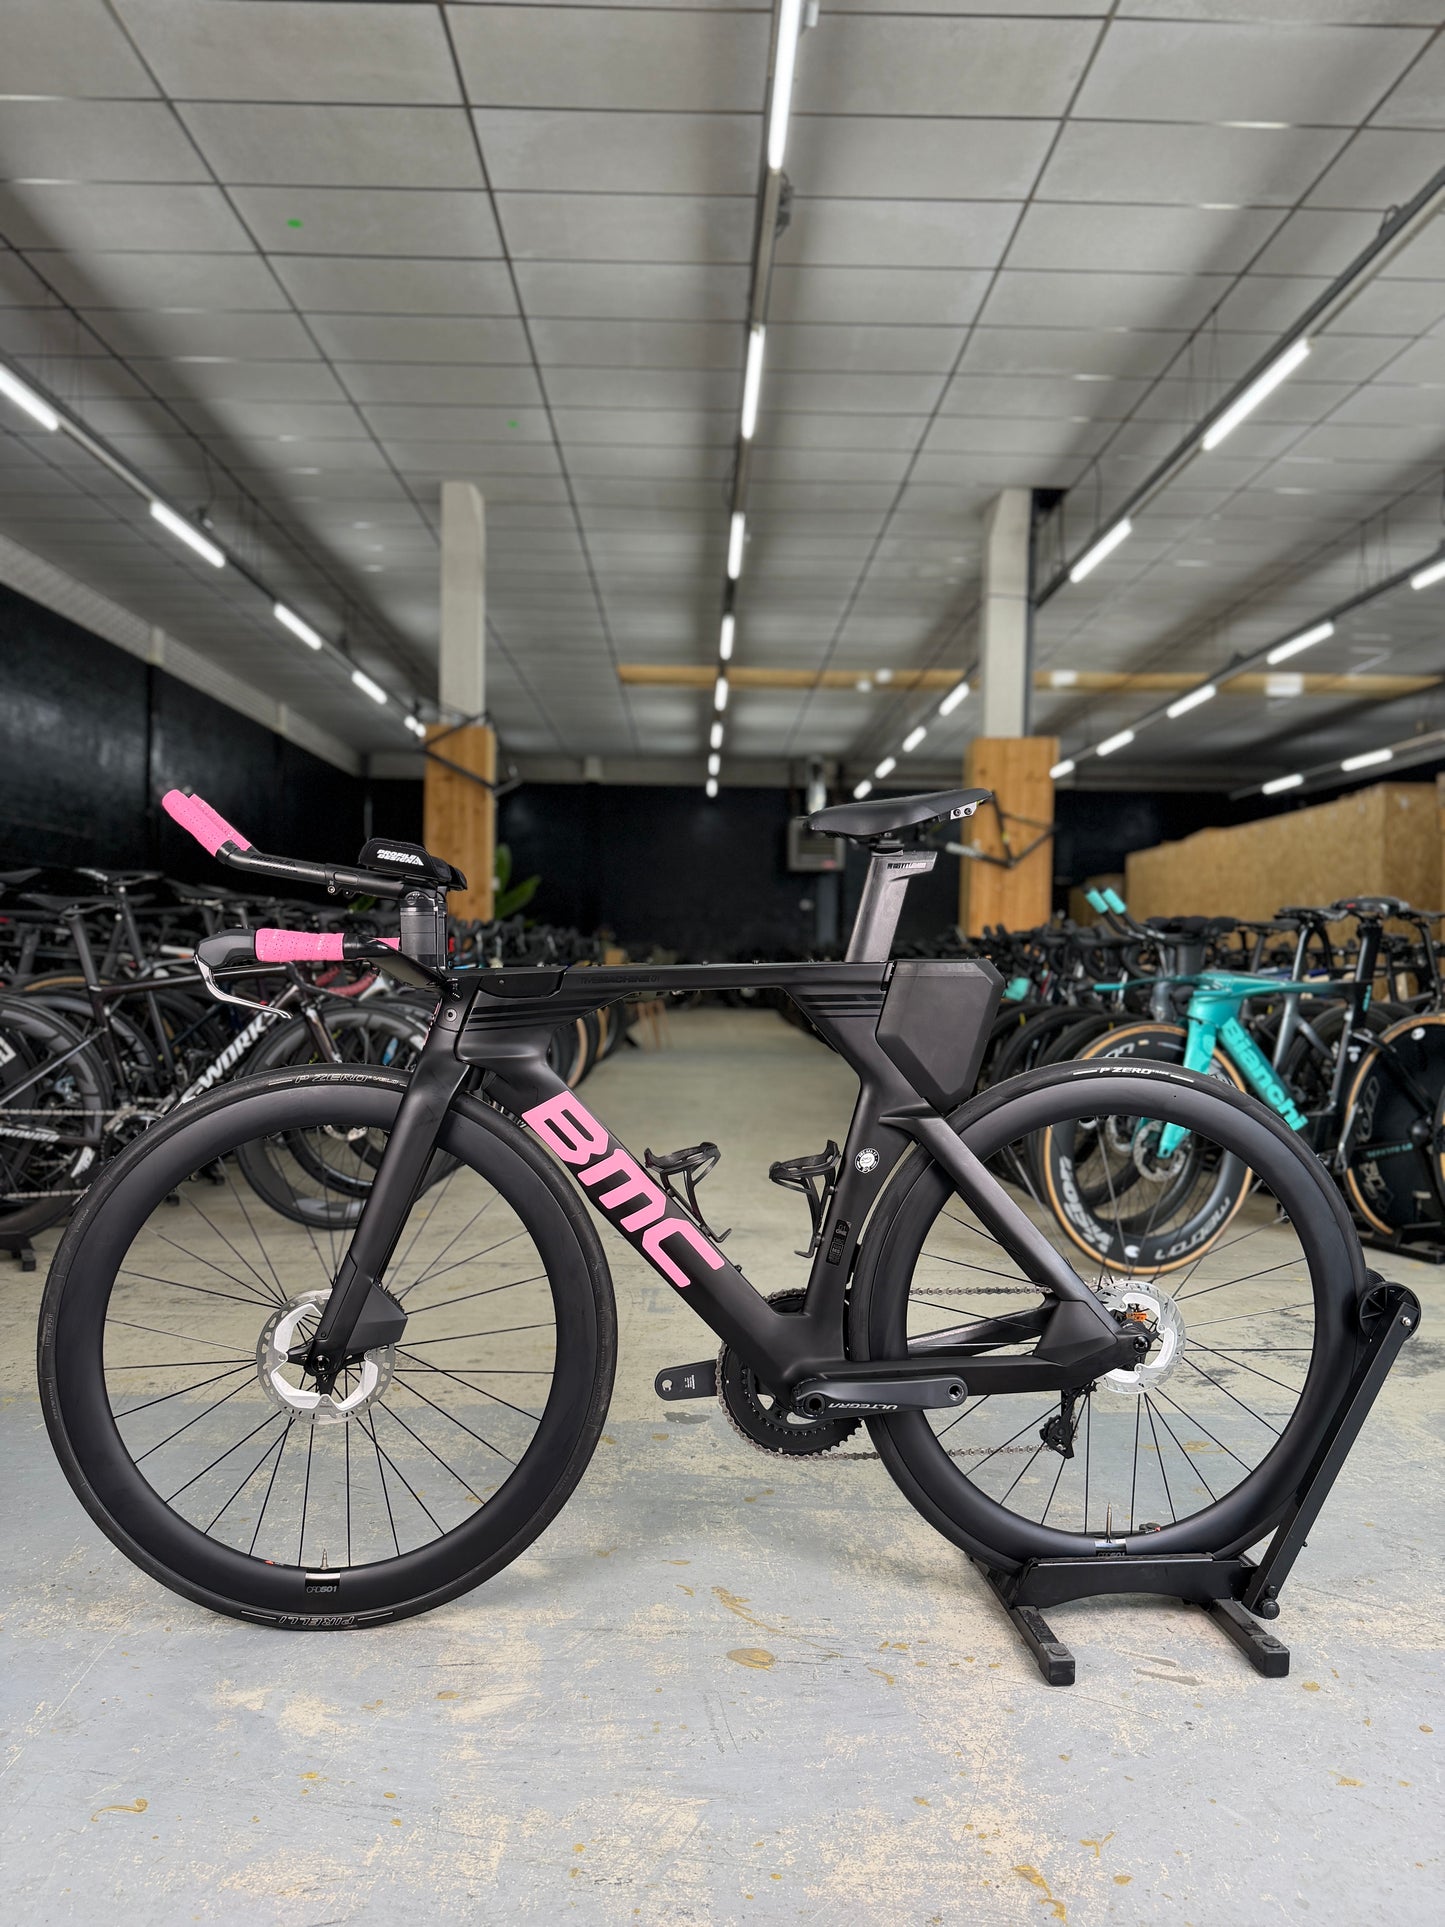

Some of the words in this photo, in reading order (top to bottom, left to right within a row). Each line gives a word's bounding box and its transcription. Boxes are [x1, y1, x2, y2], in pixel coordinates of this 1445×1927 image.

[1112, 1066, 1152, 1075] ZERO
[1221, 1017, 1309, 1132] Bianchi
[312, 1073, 368, 1083] ZERO
[521, 1090, 725, 1288] BMC
[279, 1615, 354, 1626] PIRELLI
